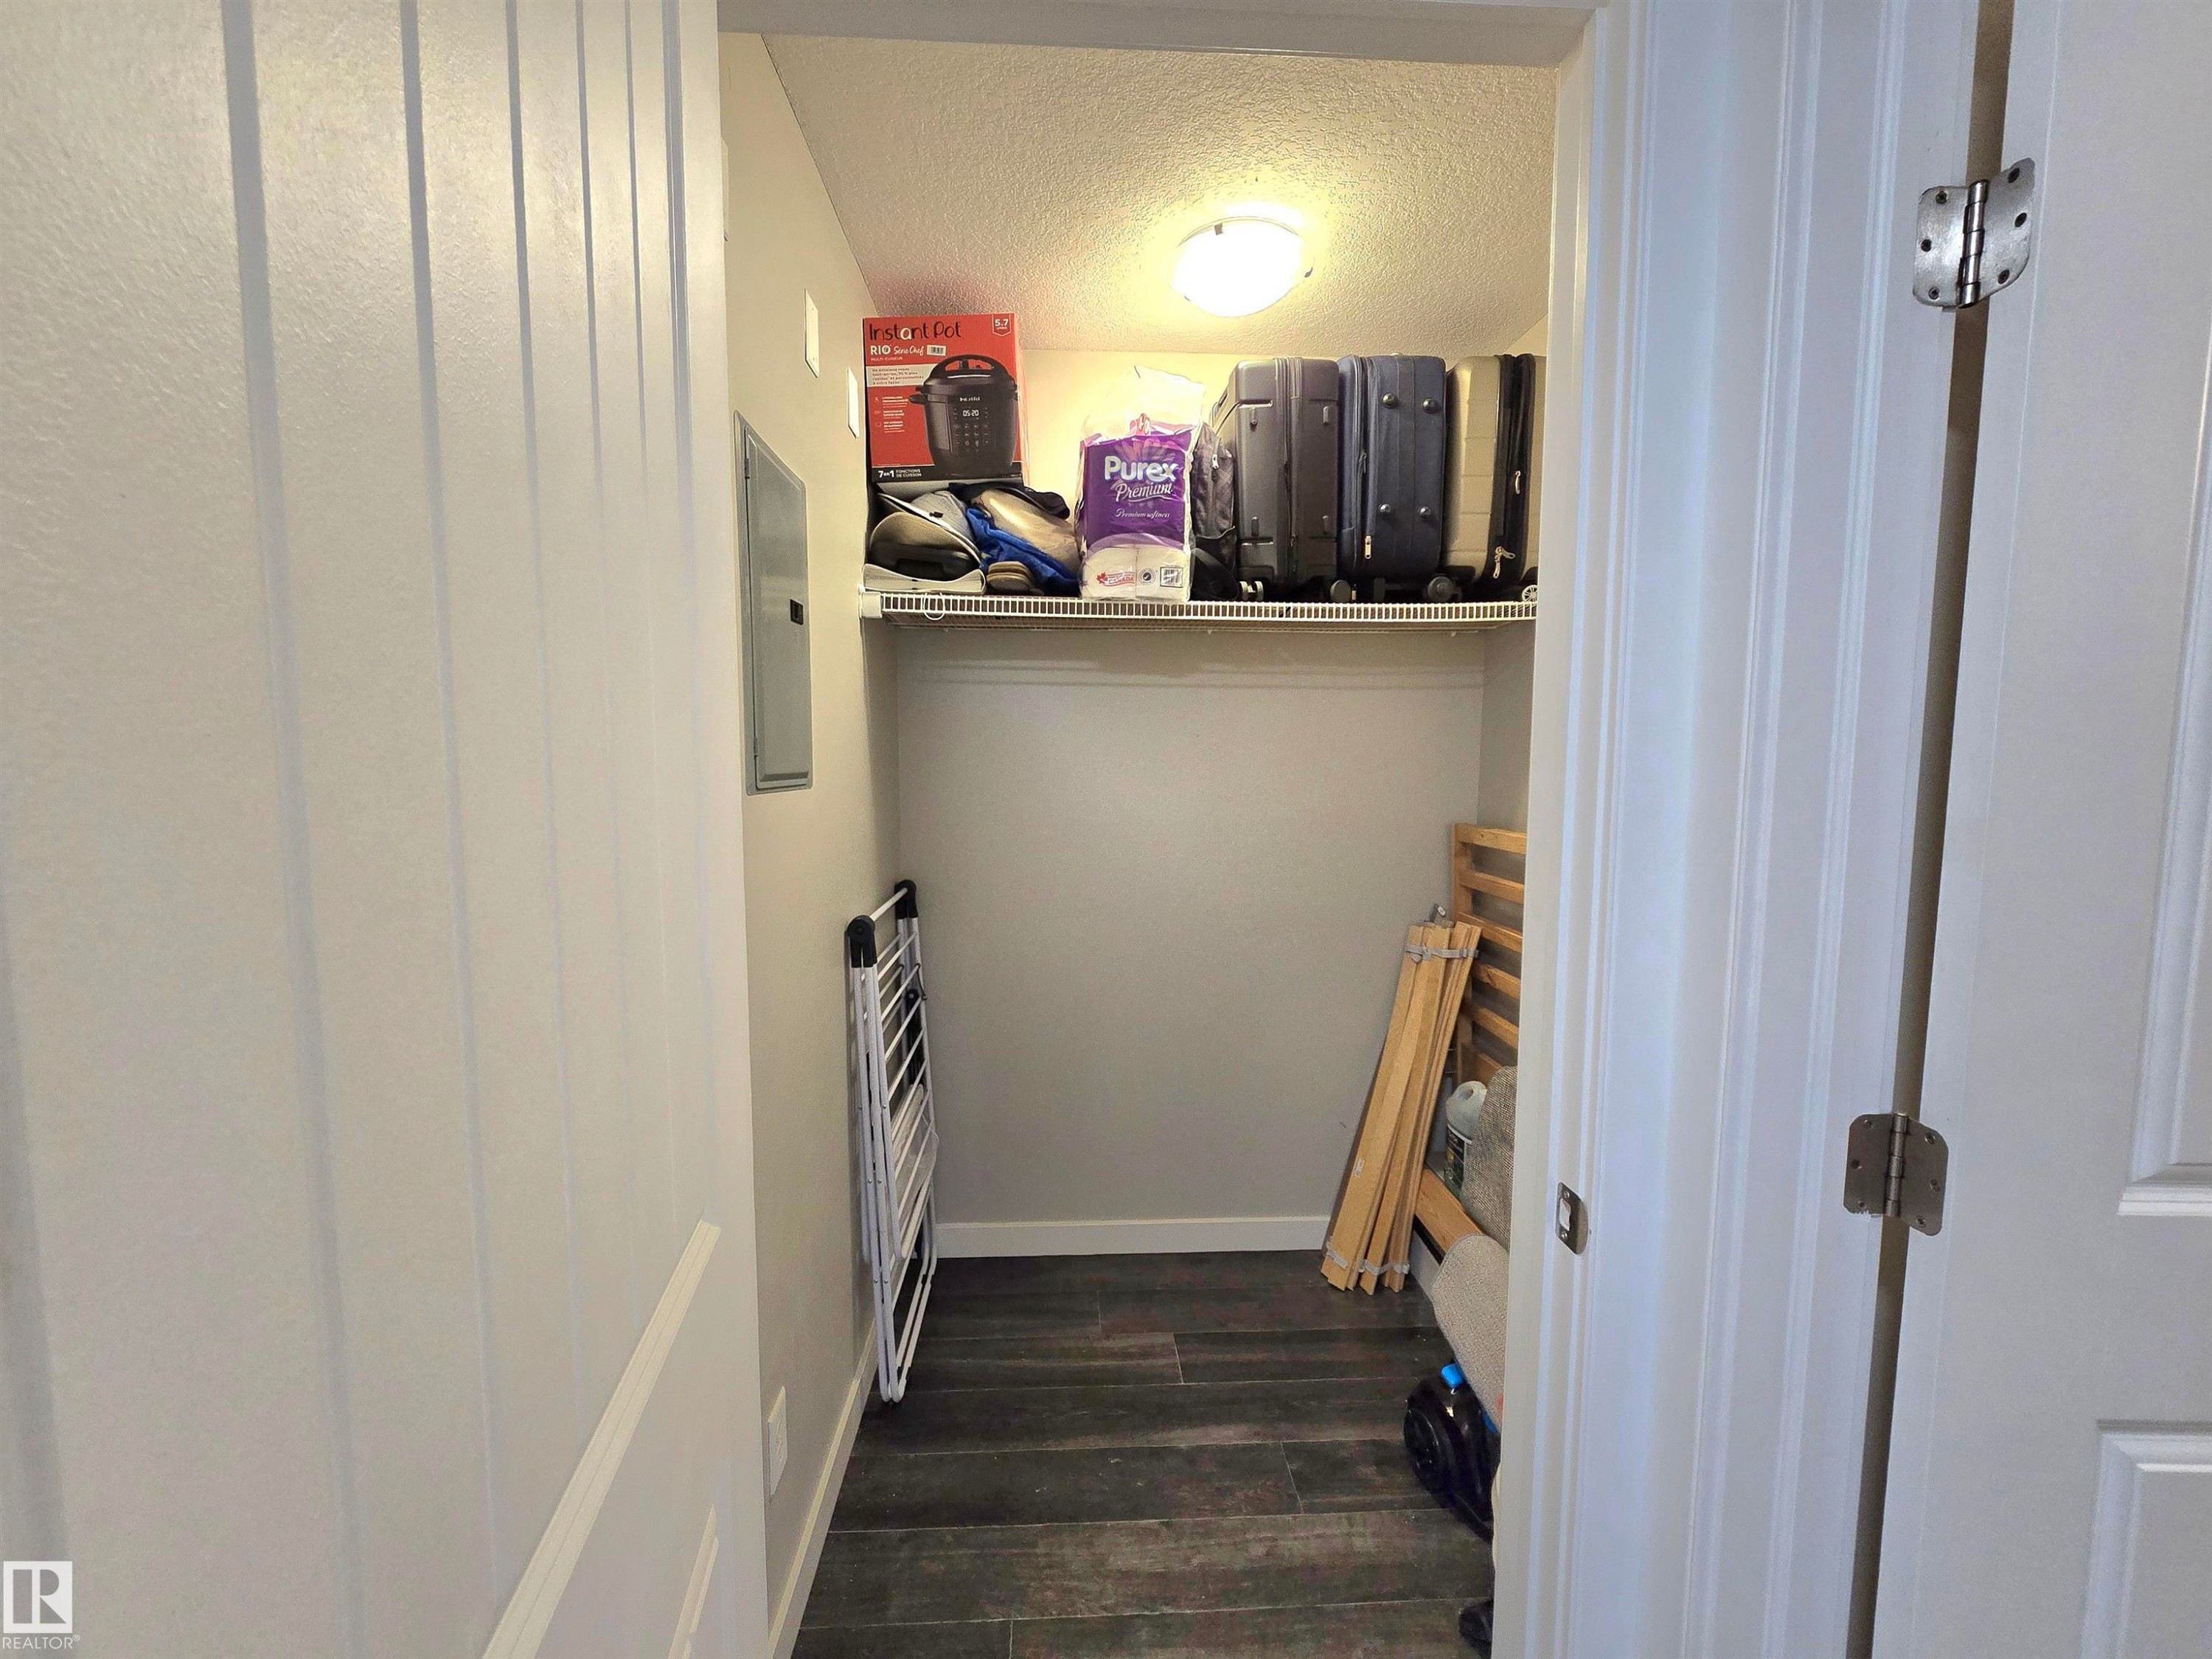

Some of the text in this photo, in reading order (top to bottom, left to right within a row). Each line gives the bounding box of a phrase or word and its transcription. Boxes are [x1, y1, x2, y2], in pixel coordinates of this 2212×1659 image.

[995, 319, 1009, 327] 5.7
[869, 321, 961, 341] Instant Pot
[870, 345, 891, 355] RIO
[909, 345, 925, 356] Chef
[1105, 455, 1178, 482] Purex
[1115, 482, 1172, 502] Premium
[1116, 508, 1170, 519] Premium softness
